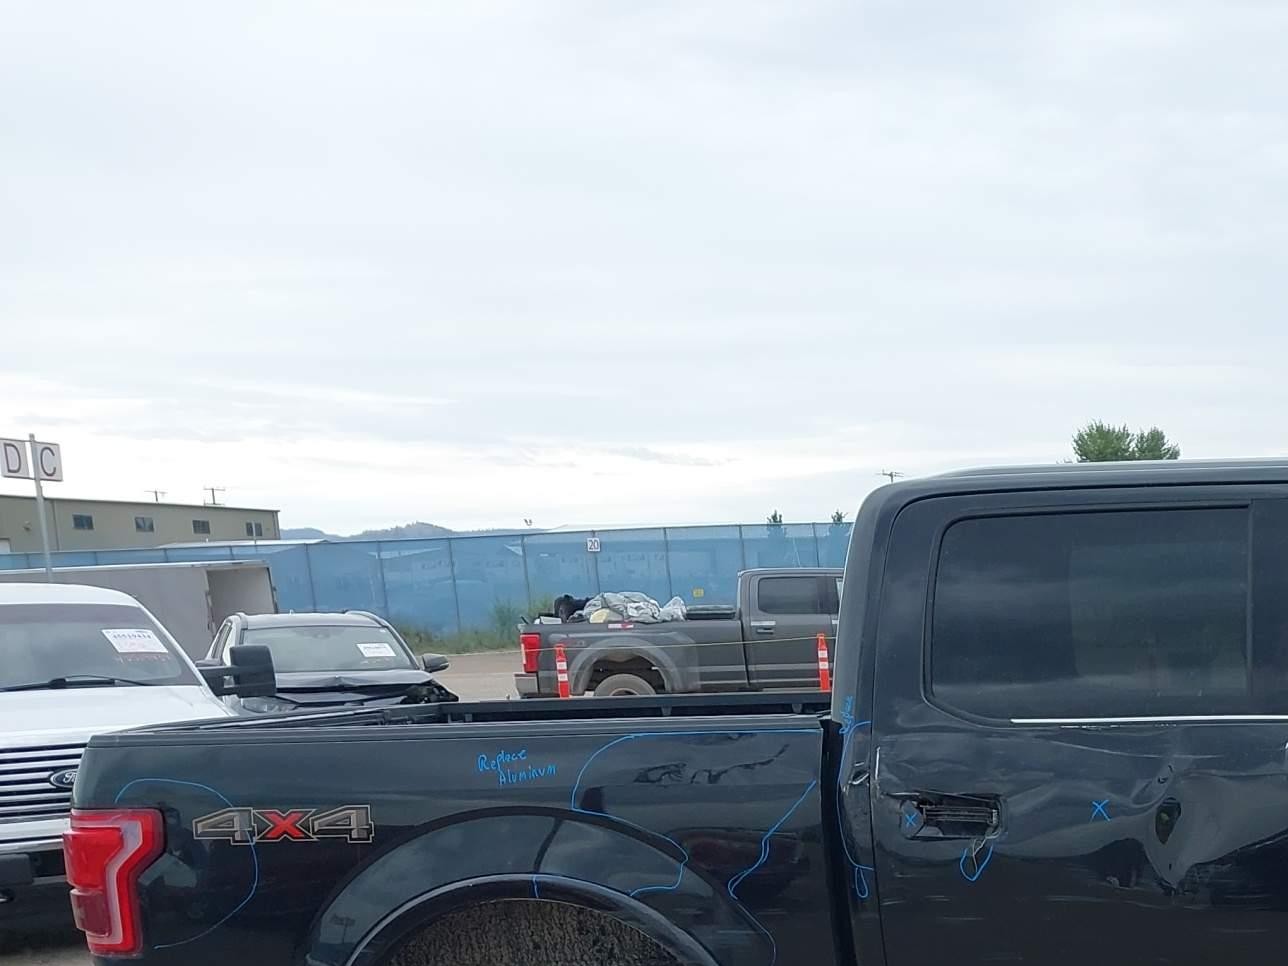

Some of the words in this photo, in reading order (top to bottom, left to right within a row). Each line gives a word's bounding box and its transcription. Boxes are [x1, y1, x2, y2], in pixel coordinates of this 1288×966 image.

[3, 442, 22, 474] D
[40, 446, 57, 477] C
[588, 539, 599, 550] 20
